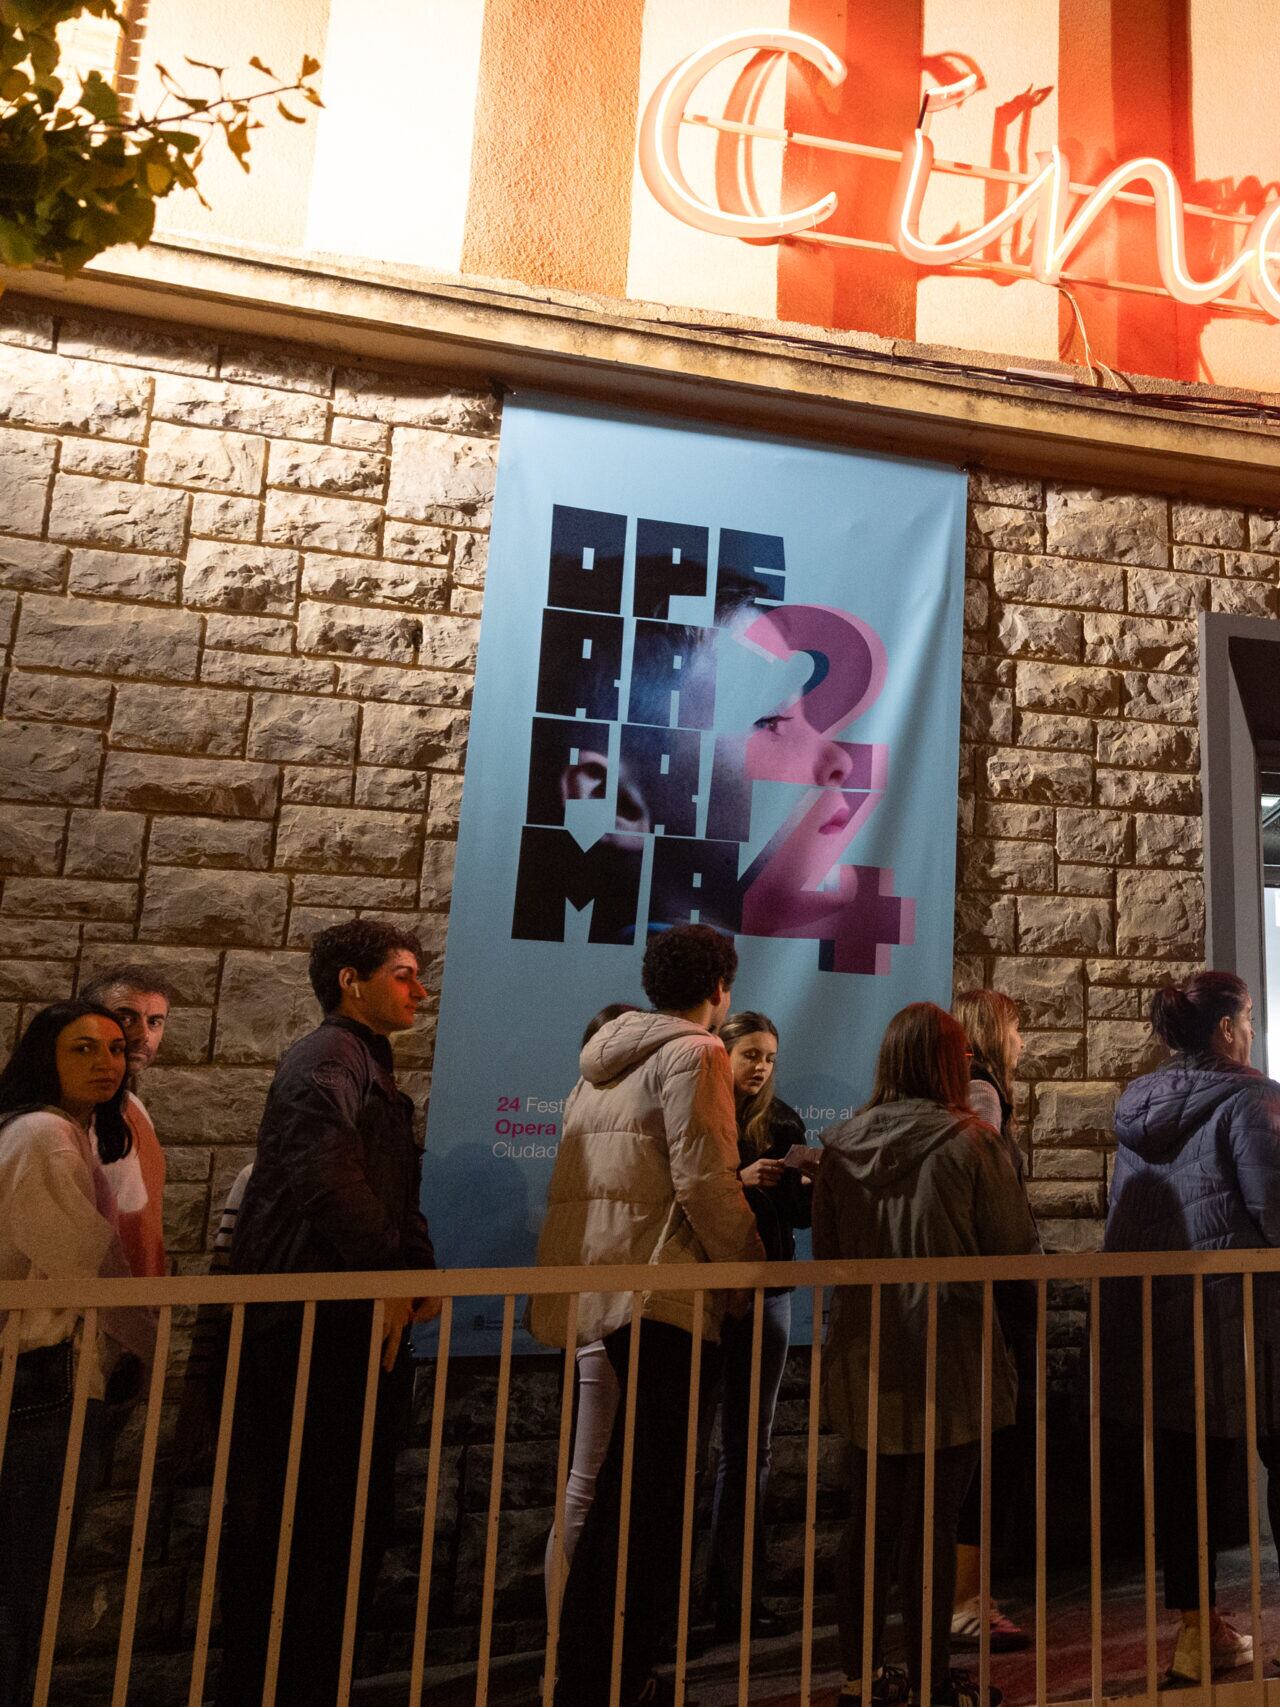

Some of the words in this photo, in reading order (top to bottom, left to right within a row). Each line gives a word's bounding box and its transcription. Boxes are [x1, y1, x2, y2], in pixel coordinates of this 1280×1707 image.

[547, 504, 787, 630] OPE
[535, 608, 720, 729] RA
[511, 825, 741, 946] MA
[496, 1096, 521, 1112] 24
[526, 1097, 565, 1113] Fest
[792, 1104, 836, 1120] tubre
[839, 1105, 853, 1119] al
[495, 1119, 557, 1139] Opera
[492, 1141, 559, 1159] Ciudad
